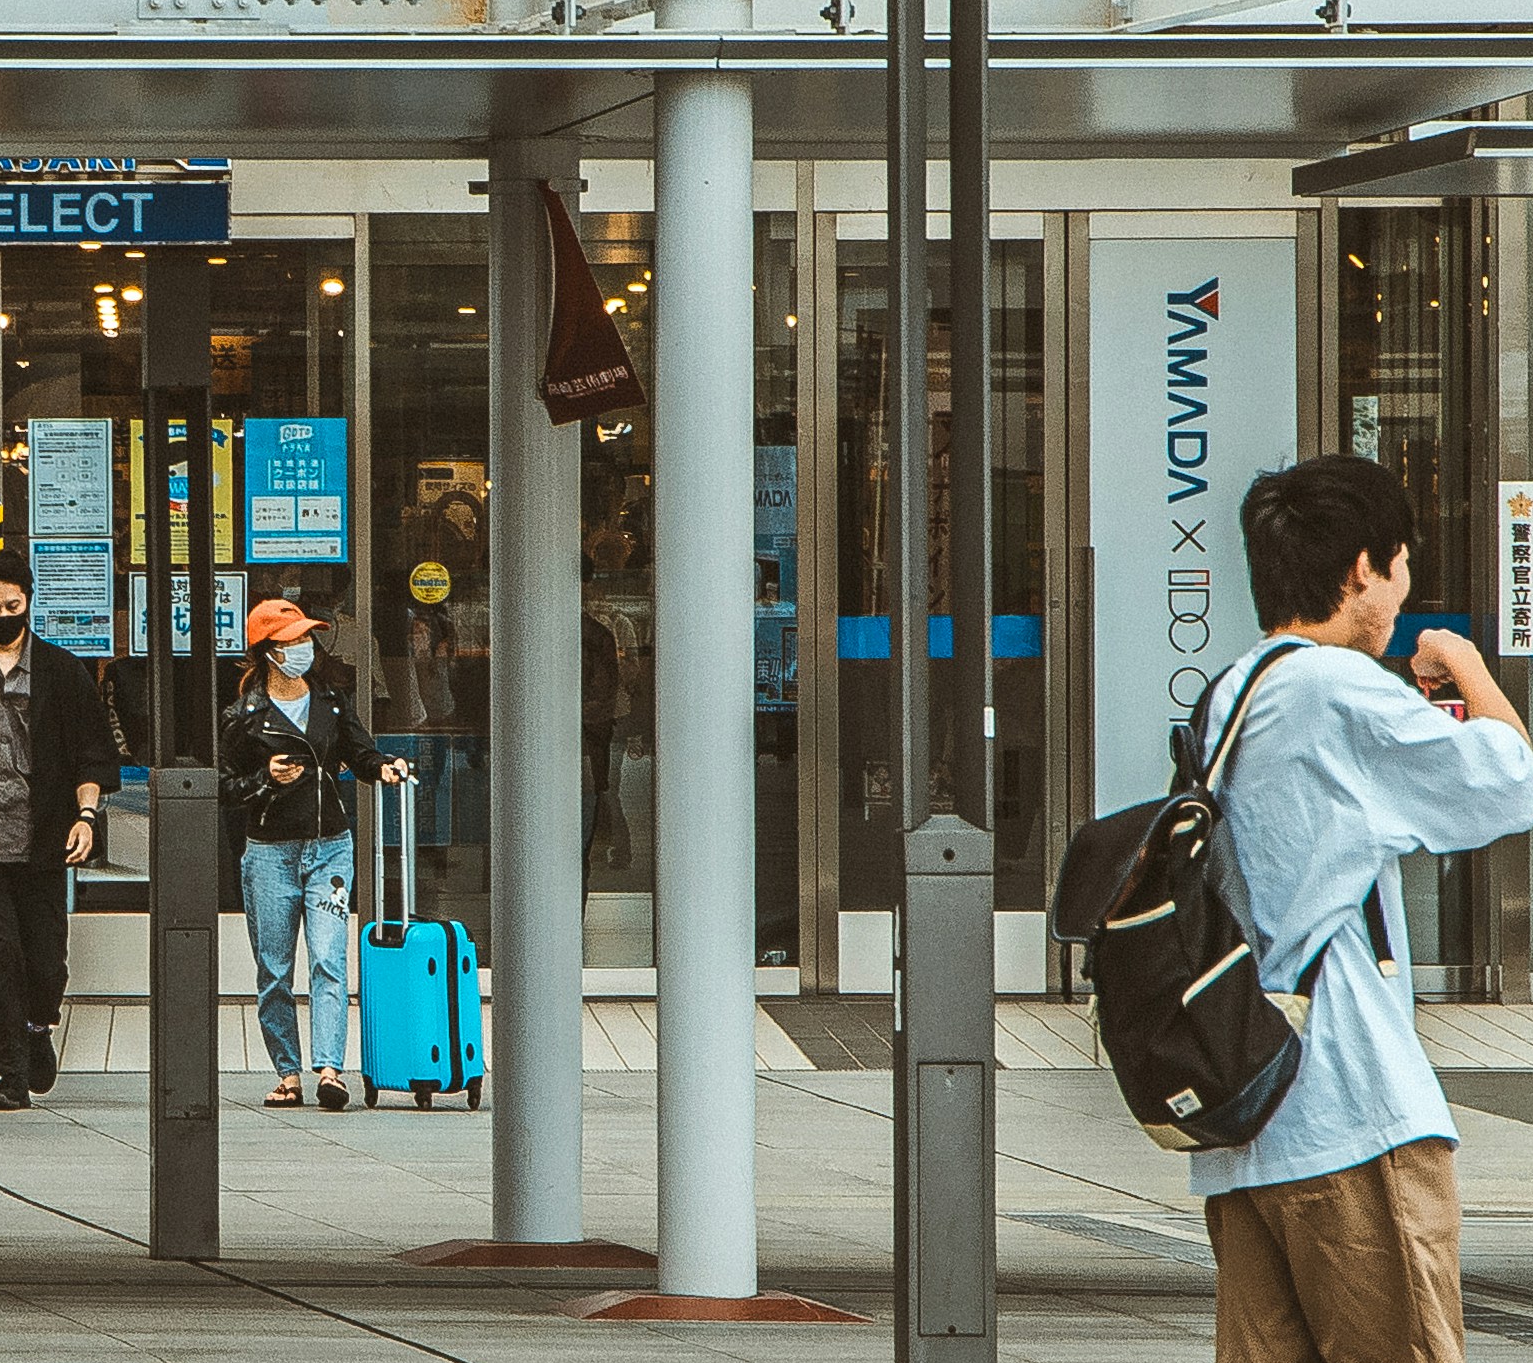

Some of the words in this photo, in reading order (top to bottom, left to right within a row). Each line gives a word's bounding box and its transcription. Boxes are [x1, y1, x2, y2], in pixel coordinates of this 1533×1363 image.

[1167, 277, 1219, 504] YAMADA
[1512, 523, 1532, 648] 警察官立寄所
